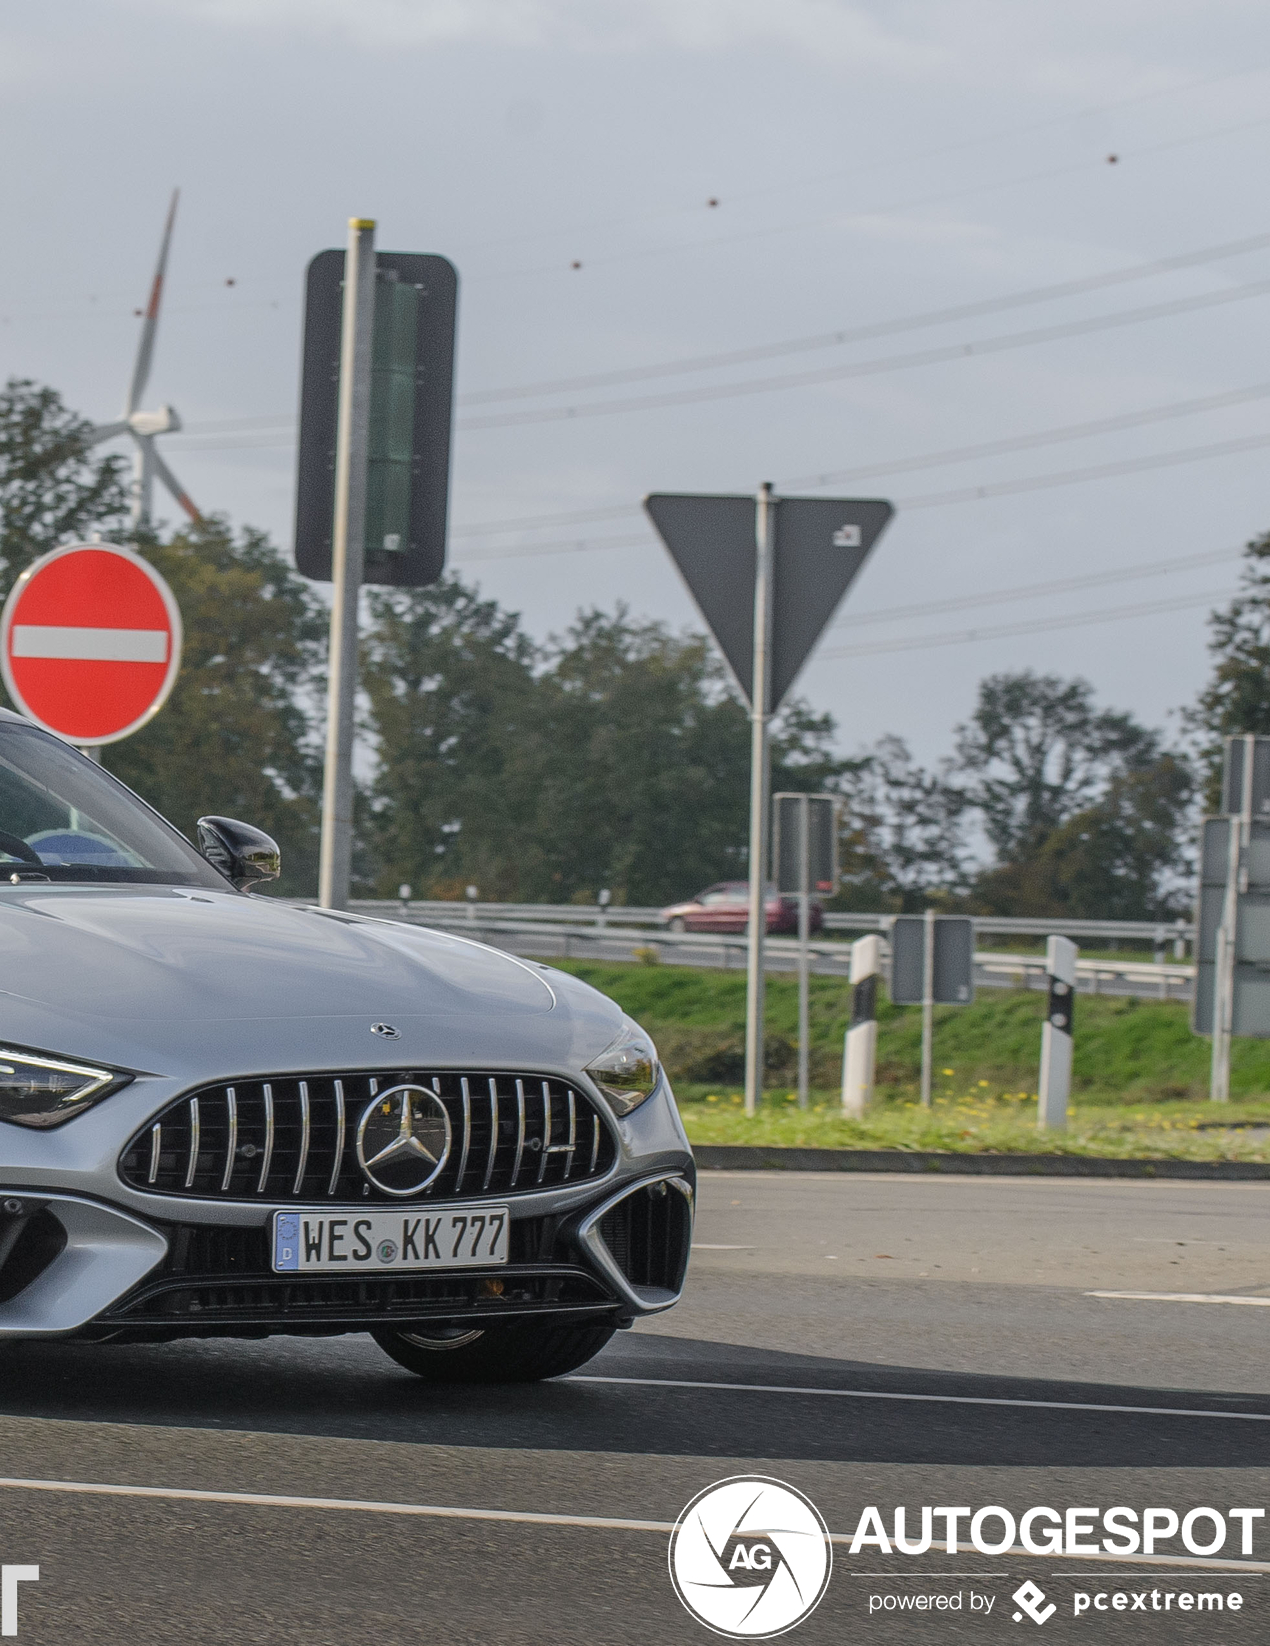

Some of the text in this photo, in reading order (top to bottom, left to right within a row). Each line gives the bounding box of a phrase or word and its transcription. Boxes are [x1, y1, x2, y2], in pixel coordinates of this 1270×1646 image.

[303, 1214, 504, 1262] WES KK 777
[282, 1247, 292, 1260] D
